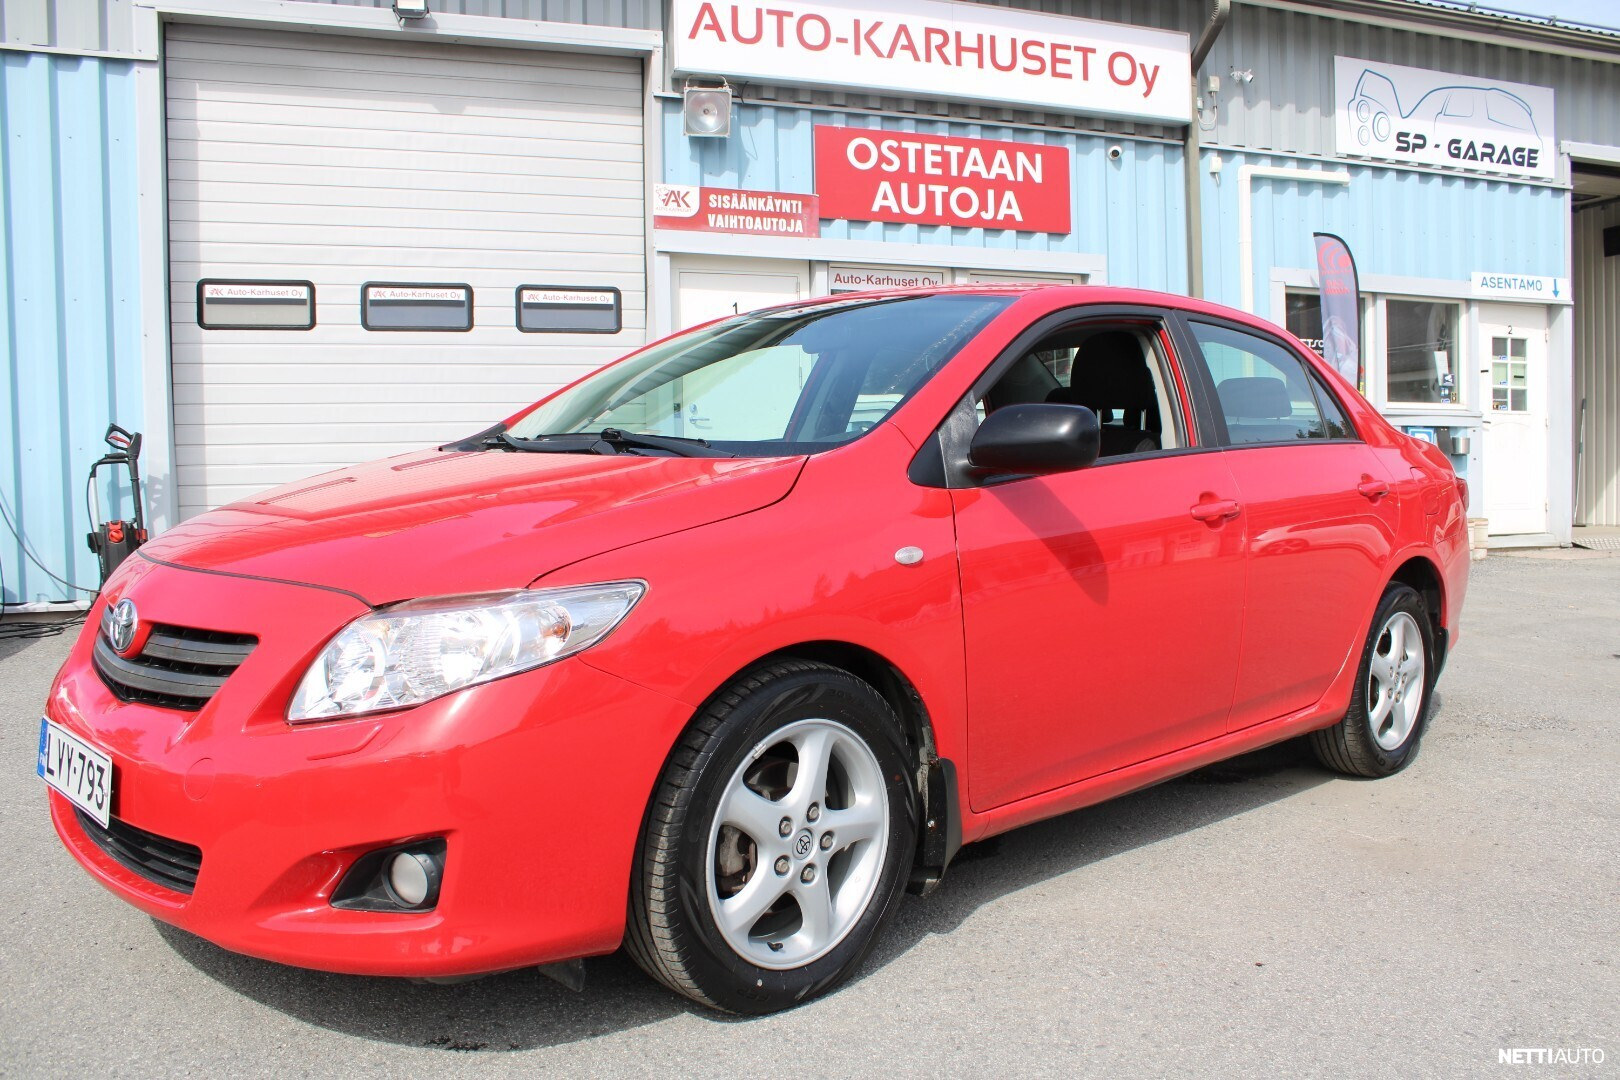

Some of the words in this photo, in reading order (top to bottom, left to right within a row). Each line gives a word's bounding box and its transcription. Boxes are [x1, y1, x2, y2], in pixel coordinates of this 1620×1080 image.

[688, 3, 1097, 81] AUTO-KARHUSET
[1107, 51, 1160, 98] Oy
[1395, 131, 1427, 153] SP
[1447, 138, 1539, 168] GARAGE
[846, 136, 1043, 184] OSTETAAN
[663, 190, 691, 208] AK
[708, 193, 803, 214] SISÄÄNKÄYNTI
[871, 181, 1024, 222] AUTOJA
[708, 213, 804, 233] VAIHTOAUTOJA
[834, 273, 919, 287] Auto-Karhuset
[1480, 276, 1543, 292] ASENTAMO
[226, 288, 289, 297] Auto-Karhuset
[291, 289, 303, 297] Oy
[389, 290, 448, 299] Auto-Karhuset
[450, 291, 461, 299] Oy
[542, 293, 598, 302] Auto-Karhuset
[599, 295, 610, 303] Oy
[732, 302, 738, 314] 1
[1507, 325, 1513, 335] 2
[46, 733, 105, 811] LVY-793
